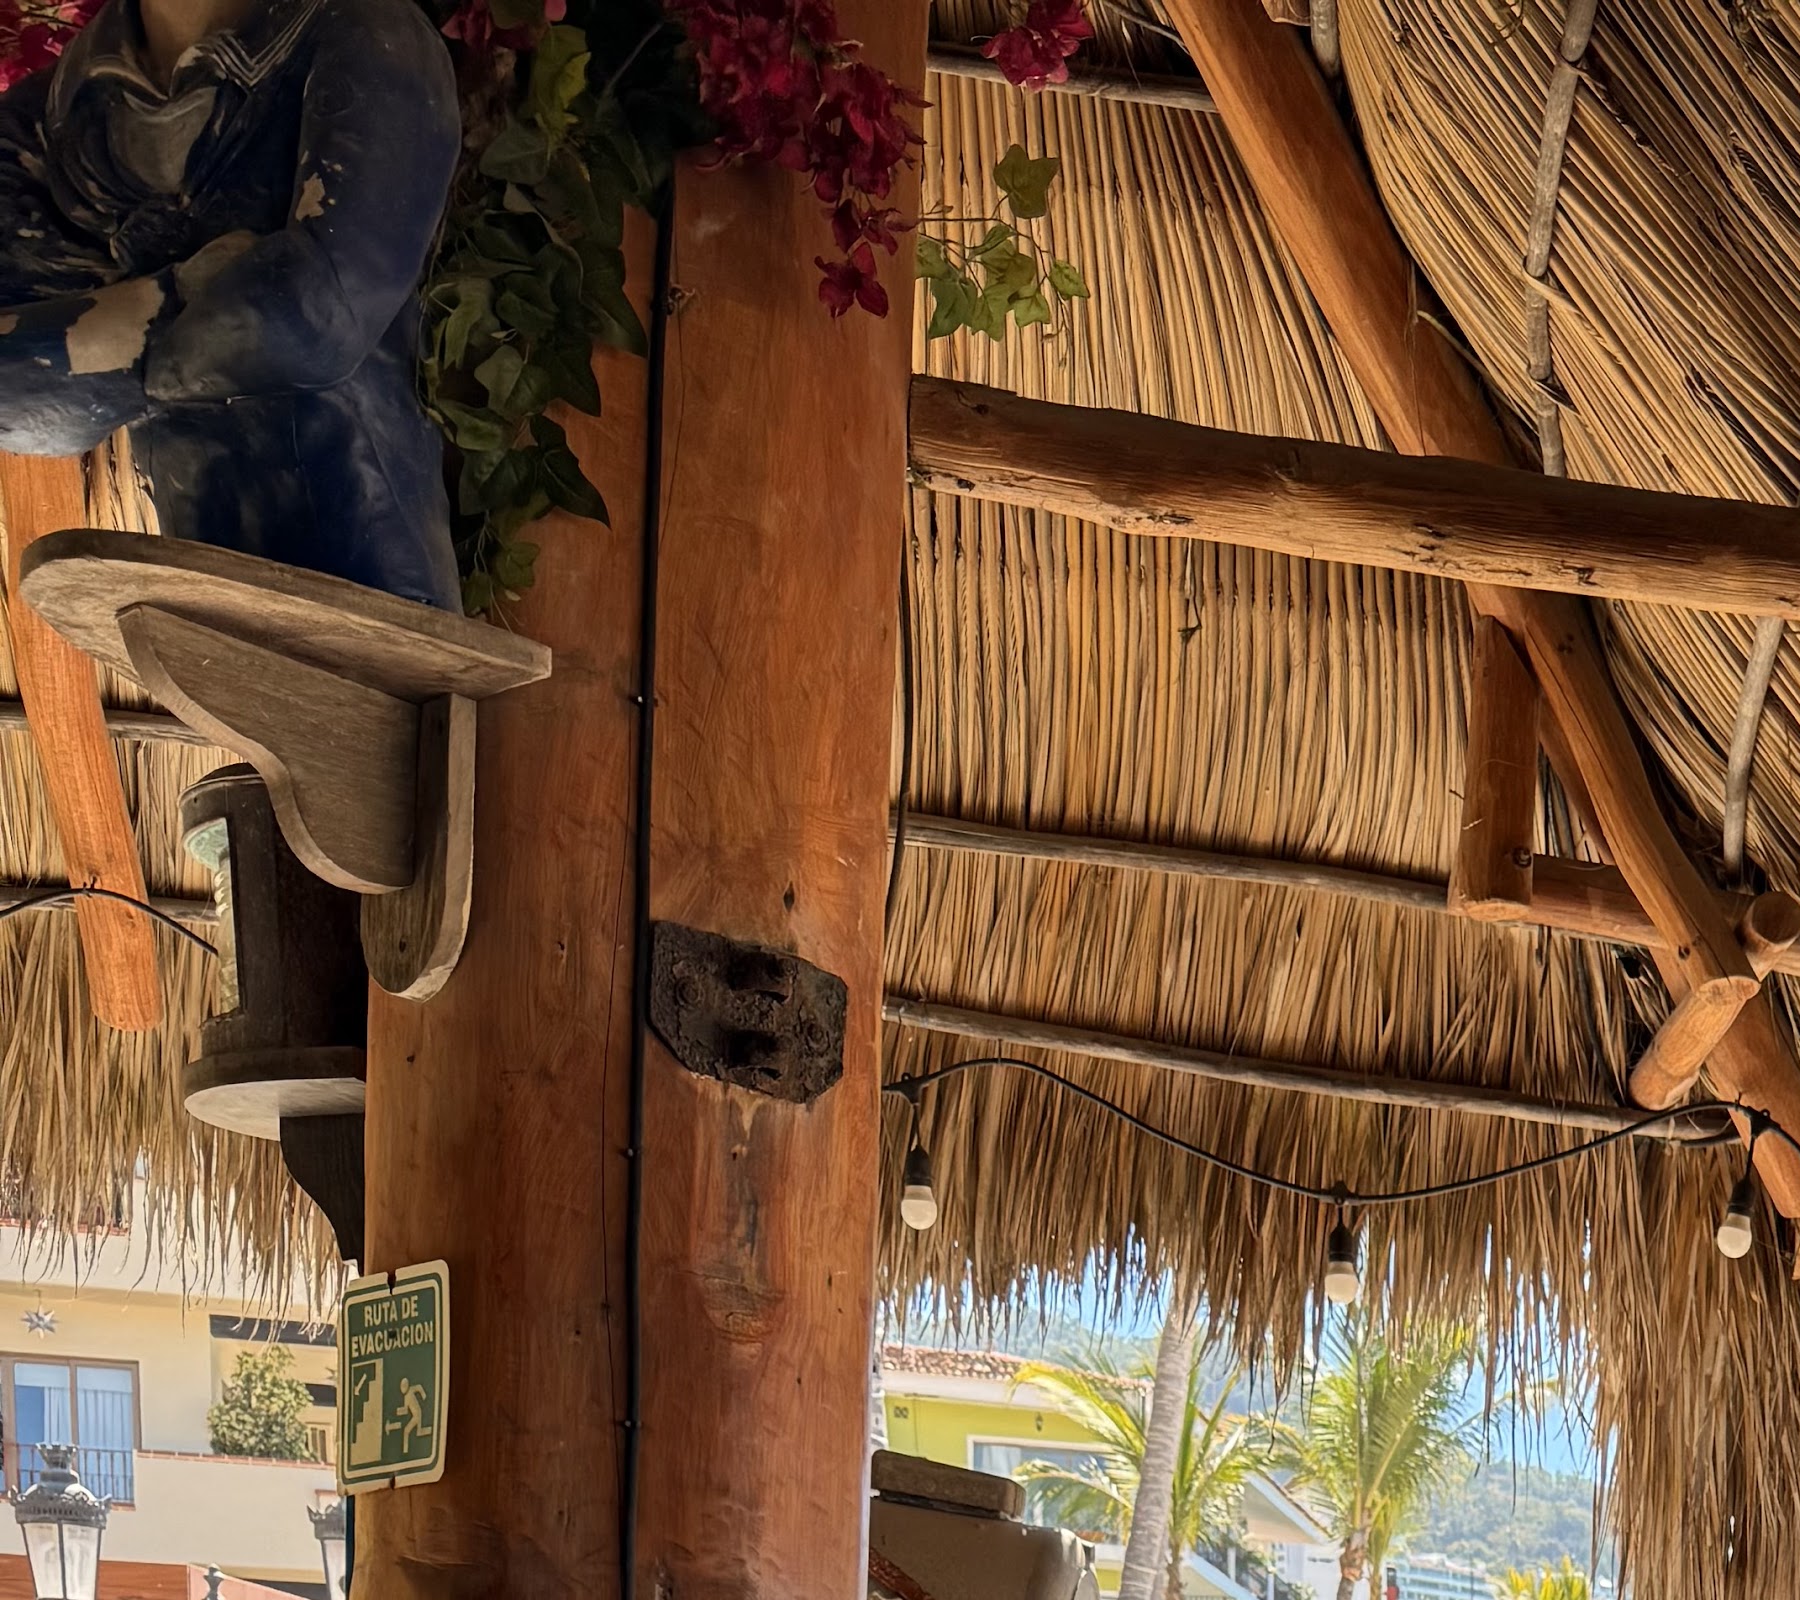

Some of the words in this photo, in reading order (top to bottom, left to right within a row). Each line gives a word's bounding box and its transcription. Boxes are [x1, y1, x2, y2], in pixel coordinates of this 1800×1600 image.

[364, 1300, 398, 1328] RUTA
[401, 1295, 419, 1320] DE
[351, 1321, 433, 1358] EVACUACION
